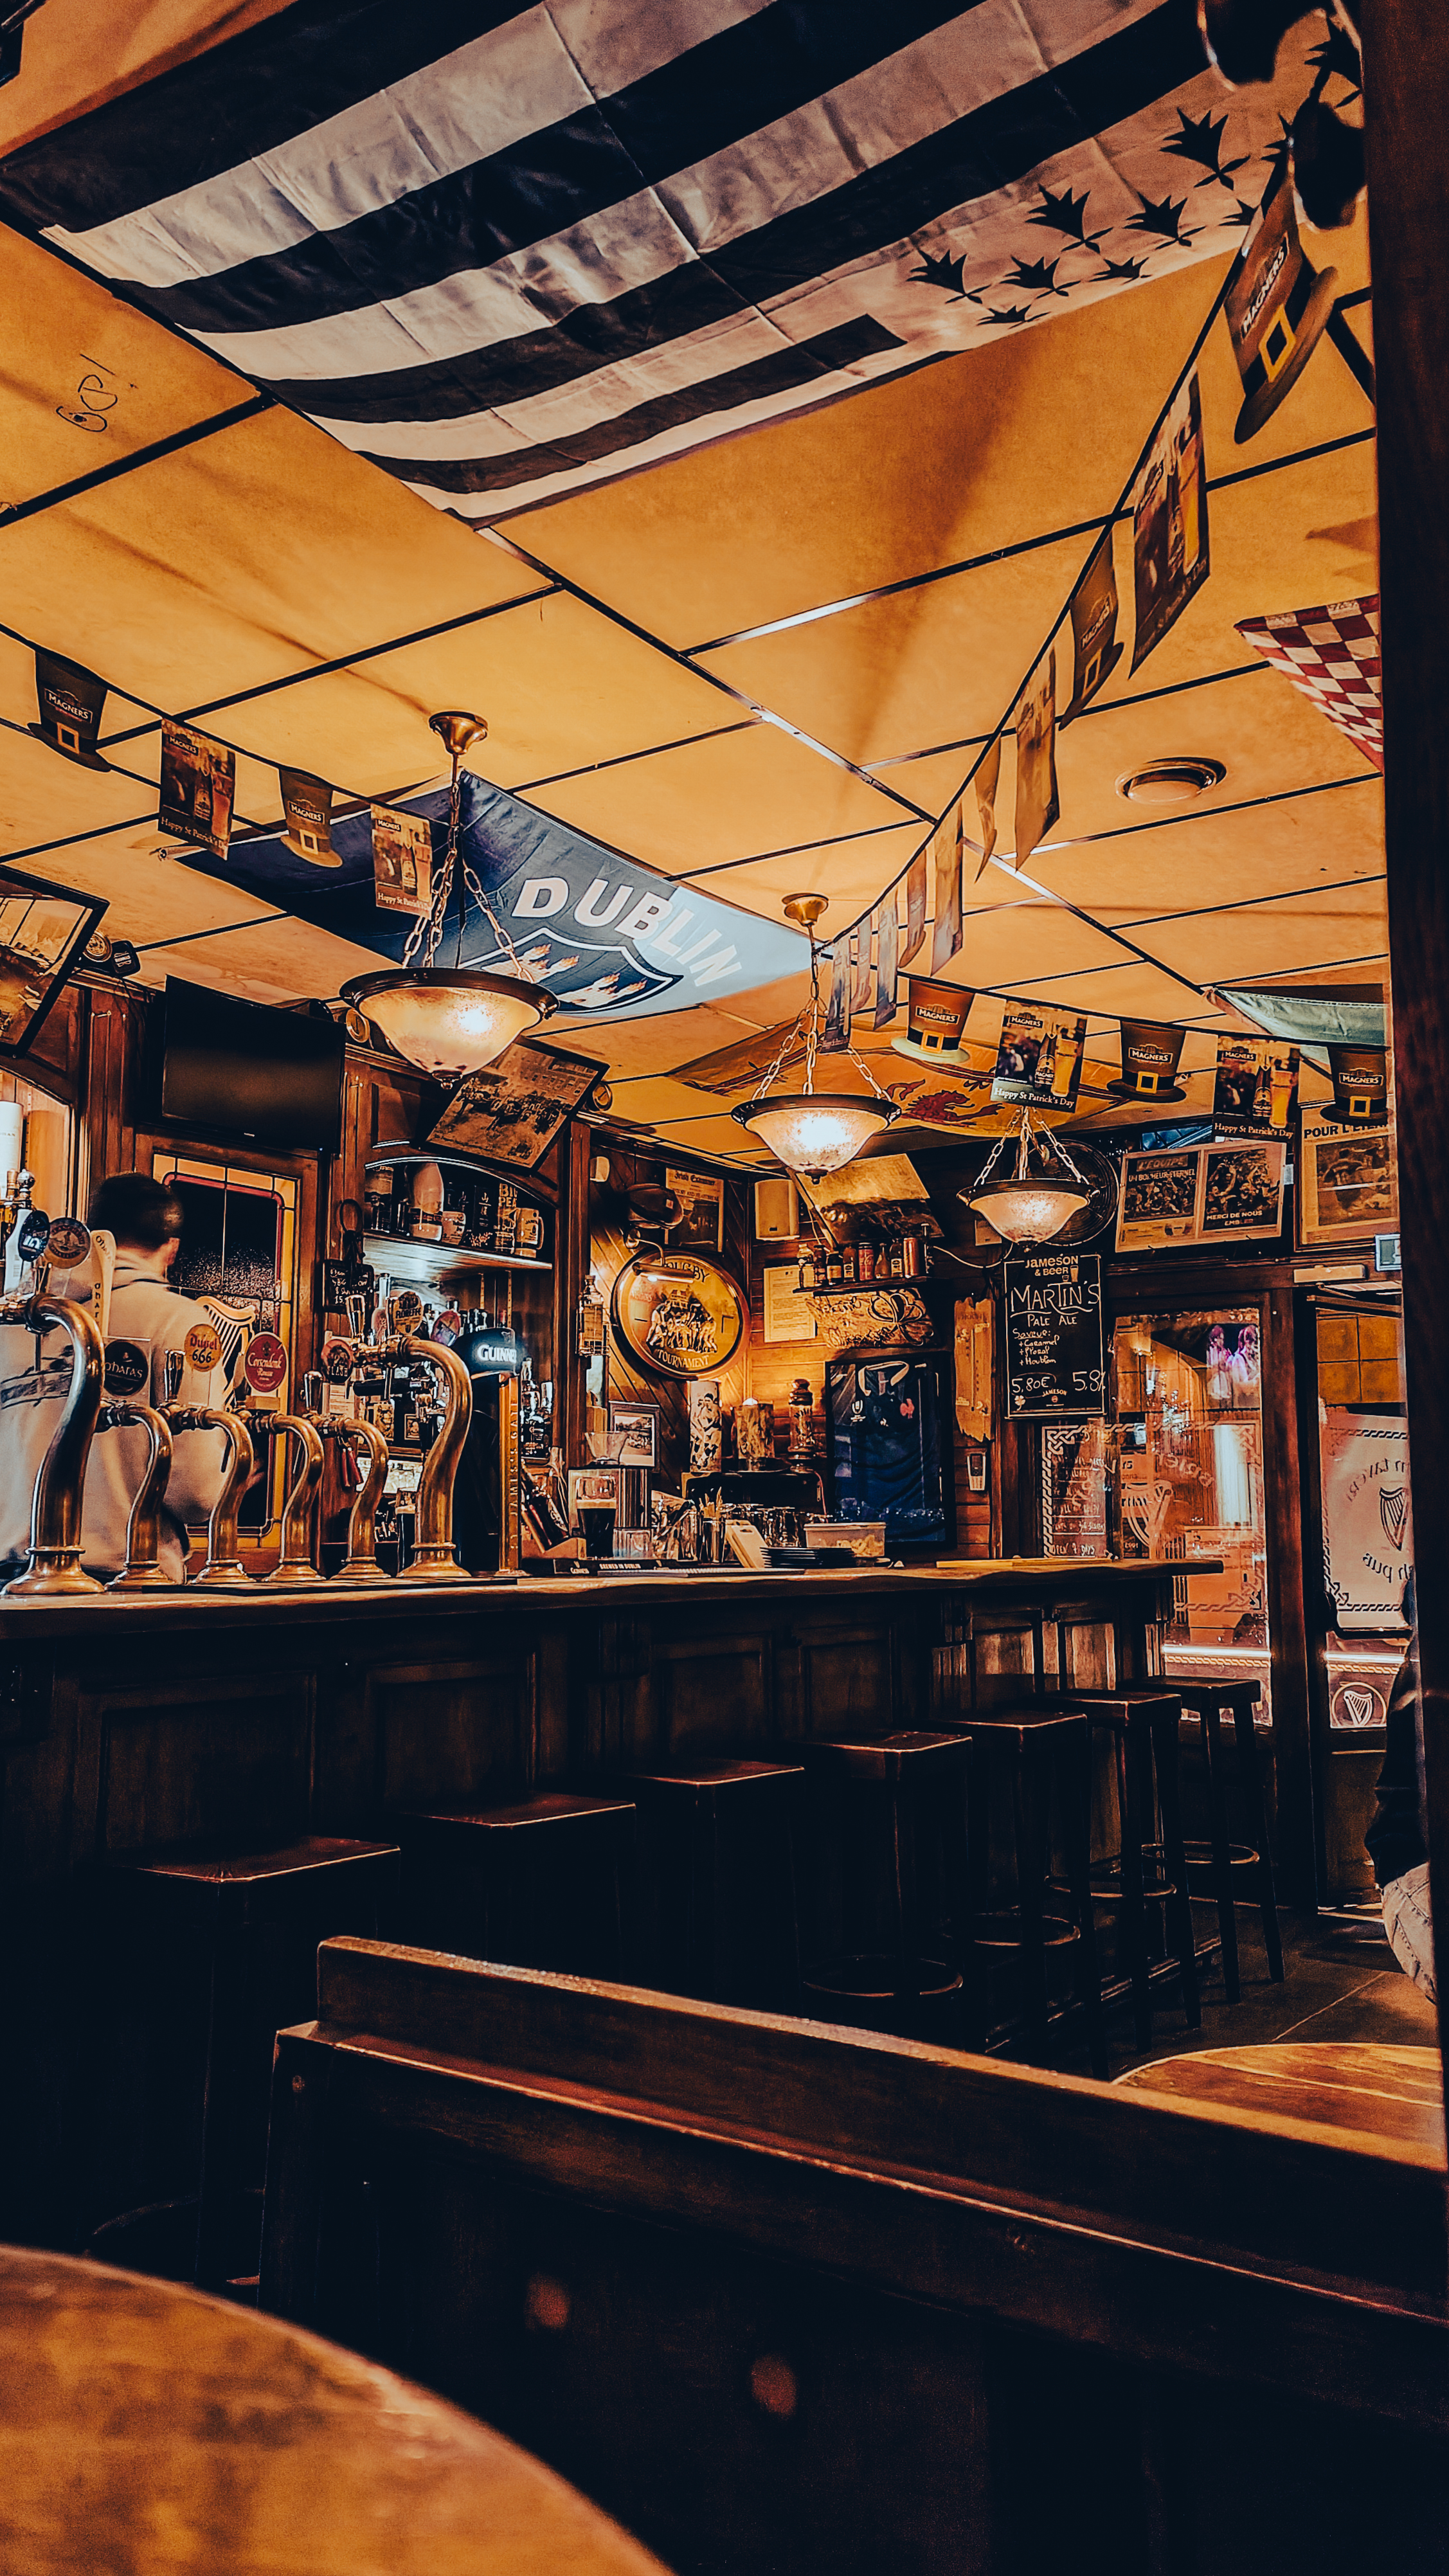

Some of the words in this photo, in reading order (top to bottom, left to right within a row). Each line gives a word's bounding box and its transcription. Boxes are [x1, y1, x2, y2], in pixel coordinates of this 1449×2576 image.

[1243, 246, 1284, 333] MAGNERS
[49, 692, 89, 719] MAGNERS
[291, 804, 322, 822] MAGNERS
[511, 876, 742, 987] DUBLIN
[918, 1009, 956, 1023] MAGNERS
[1011, 1016, 1041, 1027] MAGNERS
[1131, 1050, 1169, 1062] MAGNERS
[1225, 1050, 1254, 1060] MAGNERS
[1342, 1074, 1379, 1084] MAGNERS
[994, 1087, 1018, 1100] Happy
[1019, 1092, 1028, 1100] St
[1029, 1093, 1059, 1104] Patrick's
[1060, 1097, 1076, 1108] Day
[1214, 1122, 1238, 1134] Happy
[1239, 1124, 1247, 1133] St
[1248, 1126, 1278, 1137] Patrick's
[1279, 1129, 1294, 1139] Day
[1304, 1126, 1338, 1139] POUR
[1206, 1213, 1230, 1221] MERCI
[1034, 1268, 1041, 1277] &
[1027, 1314, 1050, 1328] PALE
[1058, 1315, 1077, 1326] ALE
[190, 1333, 217, 1351] Duvel
[657, 1349, 710, 1369] TOURNAMENT
[1041, 1389, 1068, 1398] JAMESON
